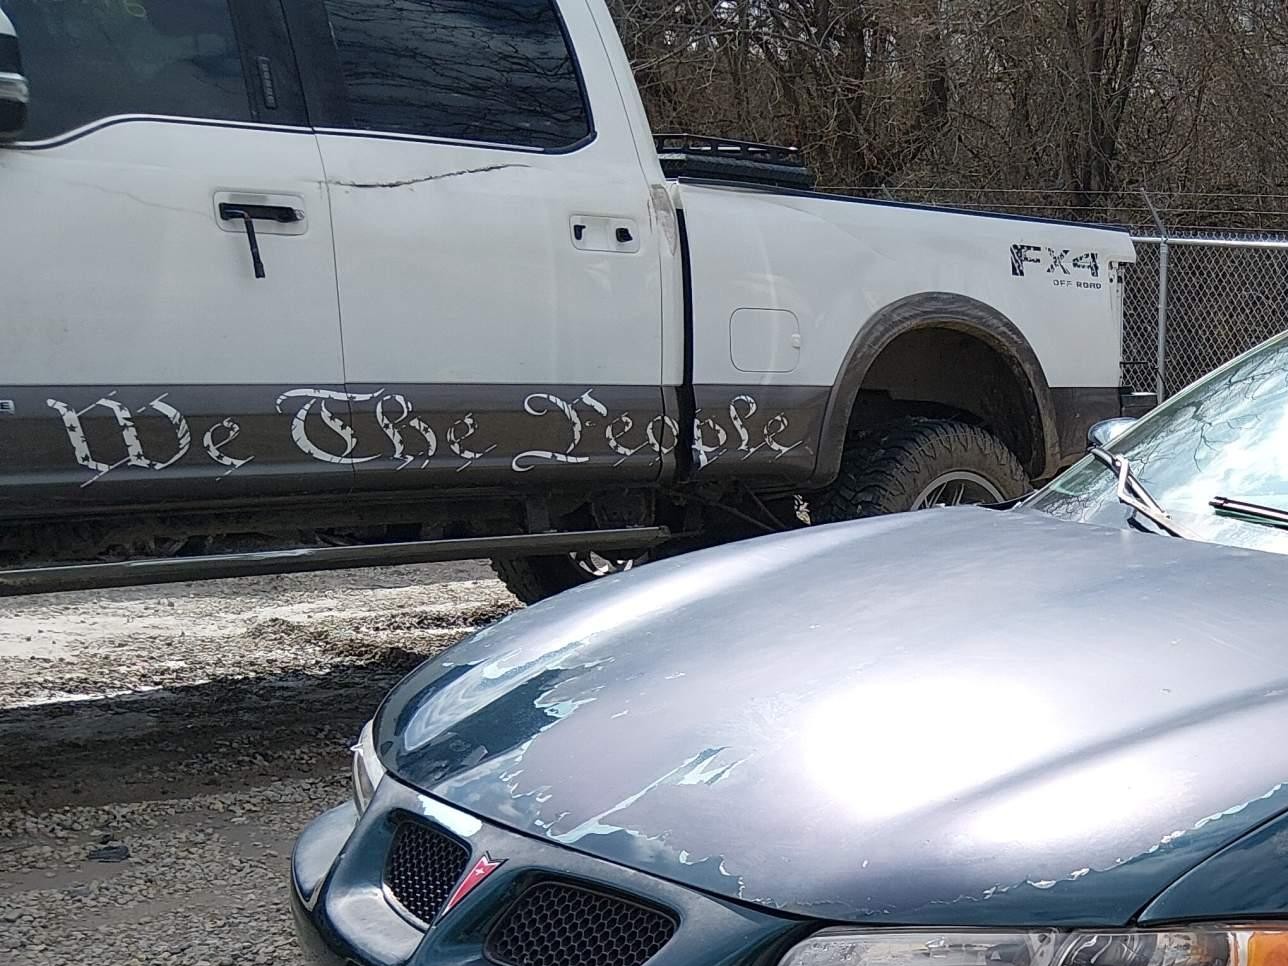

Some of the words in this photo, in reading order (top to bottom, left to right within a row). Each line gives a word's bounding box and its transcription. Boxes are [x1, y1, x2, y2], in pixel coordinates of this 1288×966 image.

[1010, 244, 1099, 277] FX4
[1053, 279, 1073, 287] OFF
[1076, 281, 1102, 289] ROAD
[46, 391, 254, 487] We
[276, 387, 497, 471] The
[511, 388, 802, 471] People
